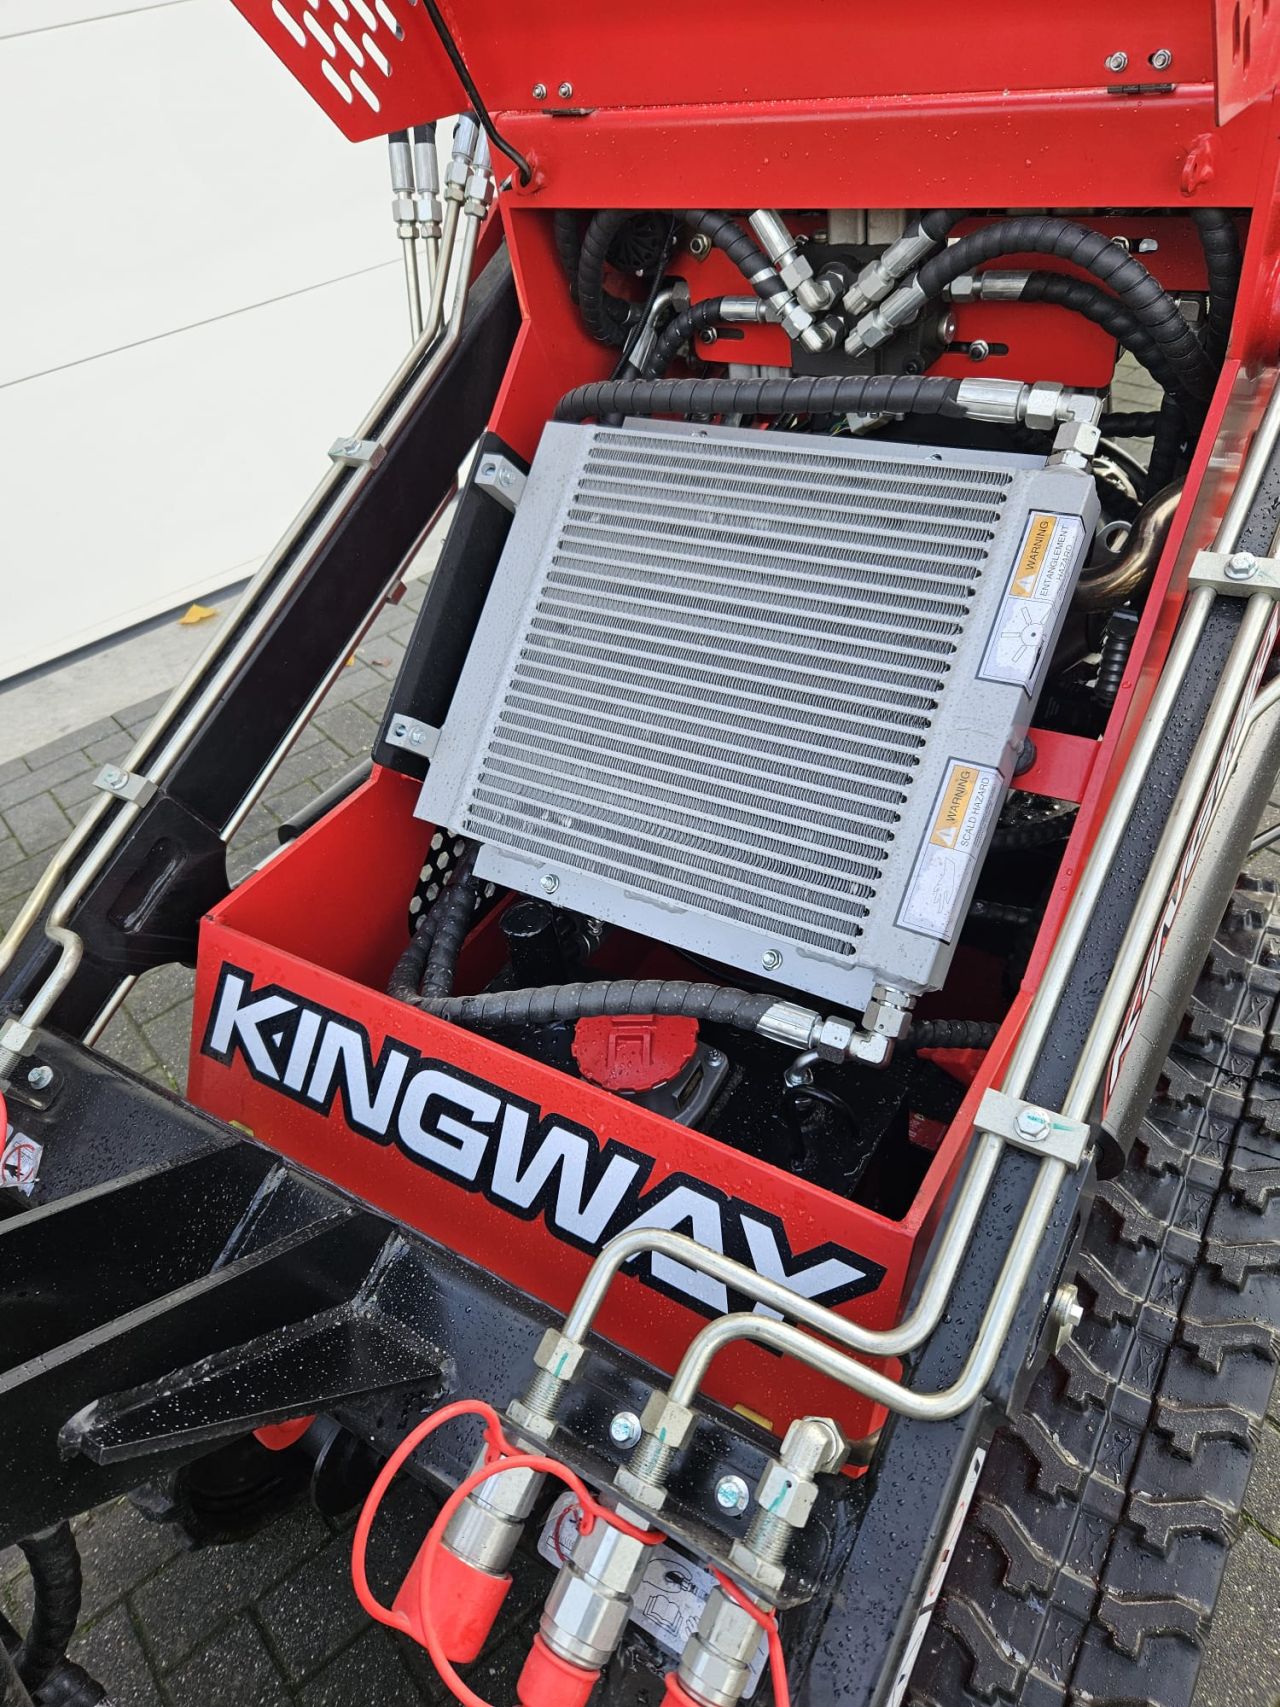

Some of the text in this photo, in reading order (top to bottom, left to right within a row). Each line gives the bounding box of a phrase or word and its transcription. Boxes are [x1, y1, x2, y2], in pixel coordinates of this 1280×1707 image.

[1025, 520, 1049, 571] WARNING
[1040, 525, 1070, 597] ENTANGLEMENT
[1057, 544, 1073, 582] HAZARD
[946, 770, 971, 823] WARNING
[961, 816, 976, 847] SCALD
[974, 777, 990, 816] HAZARD
[206, 968, 872, 1328] KINGWAY
